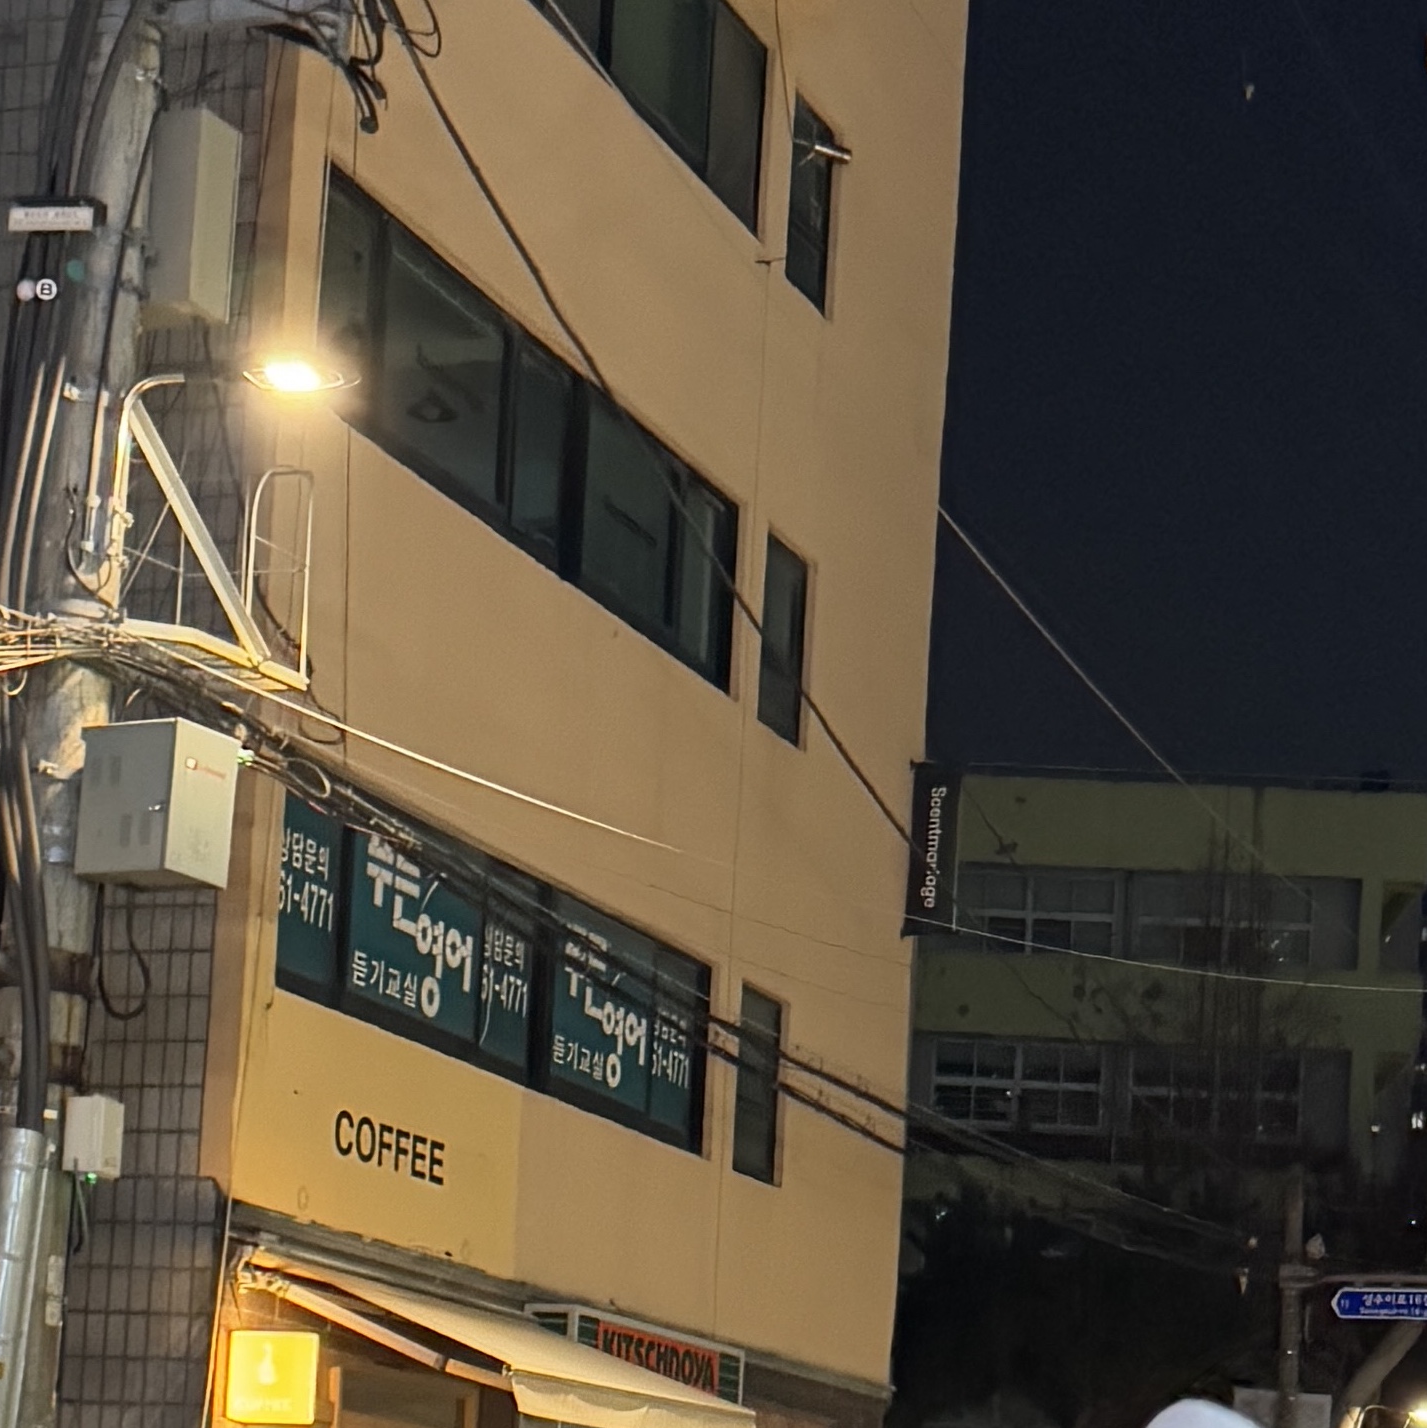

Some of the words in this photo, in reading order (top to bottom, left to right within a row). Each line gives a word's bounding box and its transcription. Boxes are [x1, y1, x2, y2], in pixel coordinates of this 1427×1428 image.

[351, 949, 418, 1008] 듣기교실
[552, 1034, 604, 1081] 듣기교실
[335, 1110, 445, 1186] COFFEE
